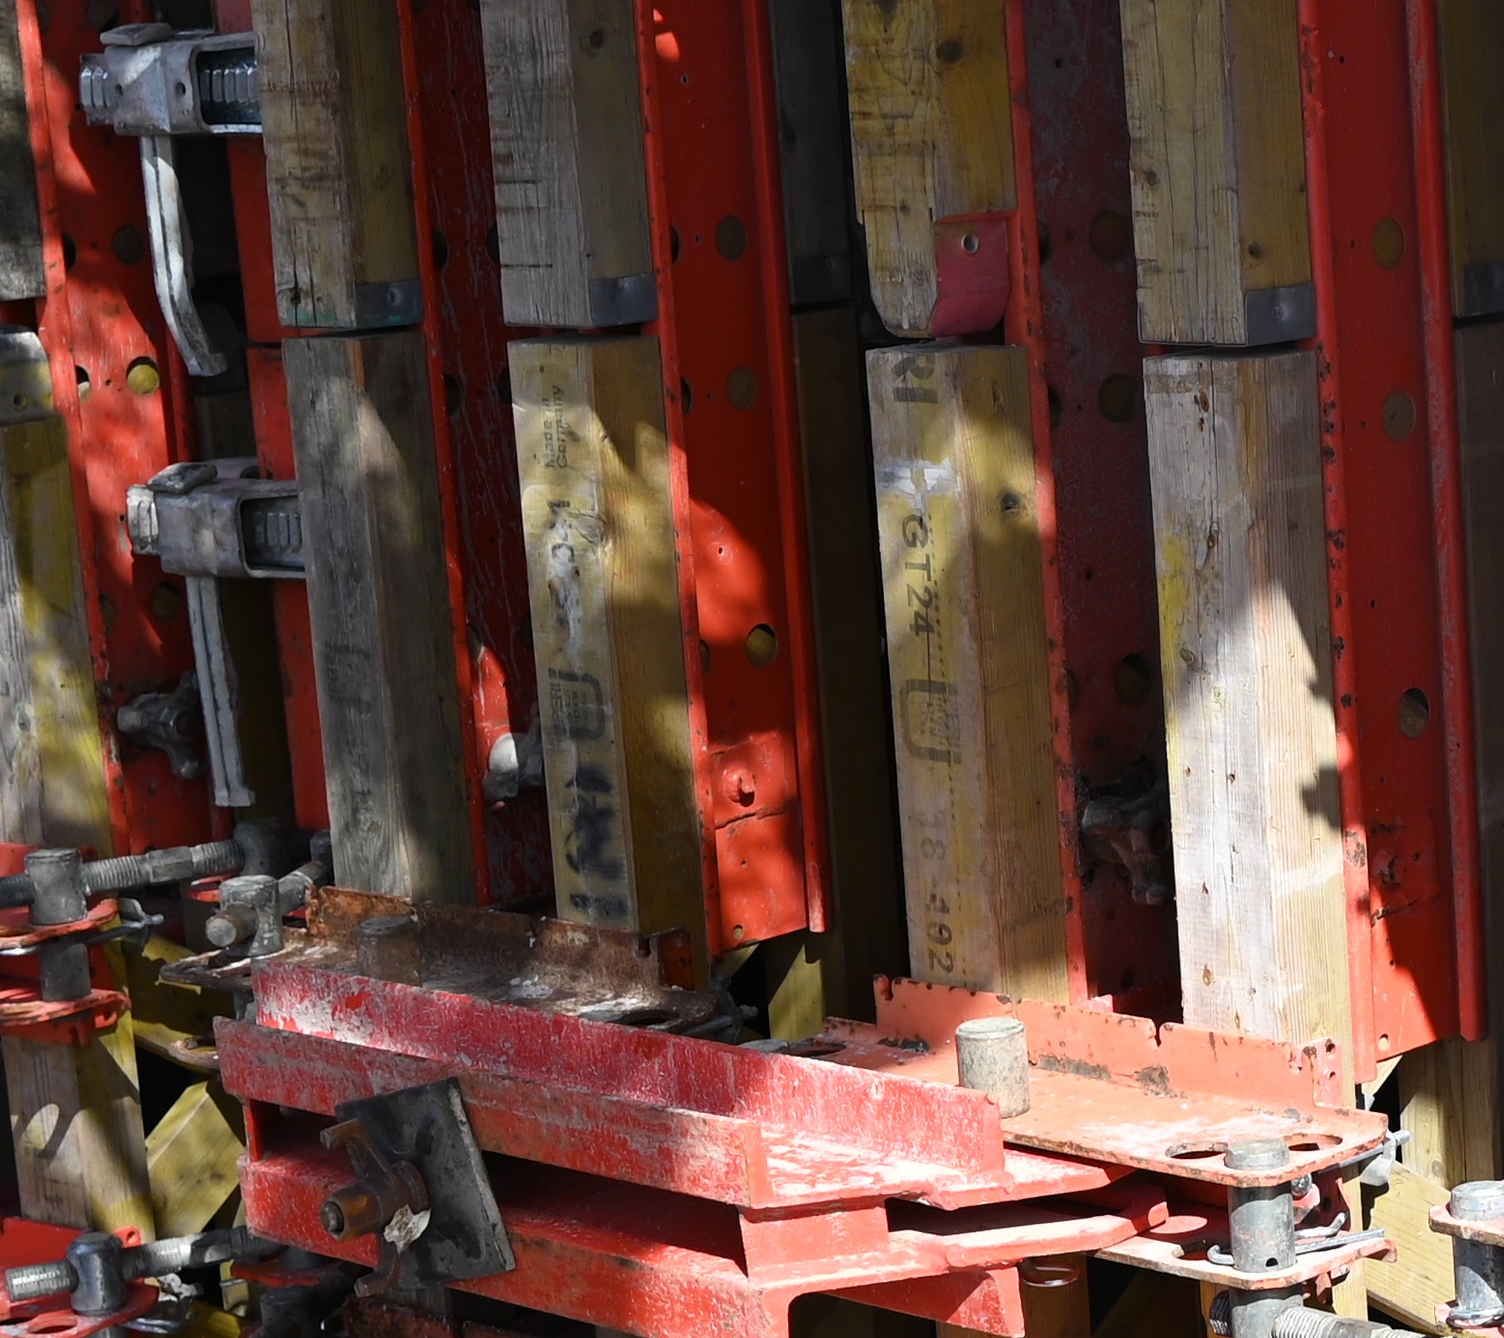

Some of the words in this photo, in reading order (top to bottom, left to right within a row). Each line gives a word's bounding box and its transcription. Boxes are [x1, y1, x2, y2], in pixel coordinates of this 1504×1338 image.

[541, 420, 556, 468] Made
[551, 385, 569, 468] Germany
[901, 513, 935, 636] GT24
